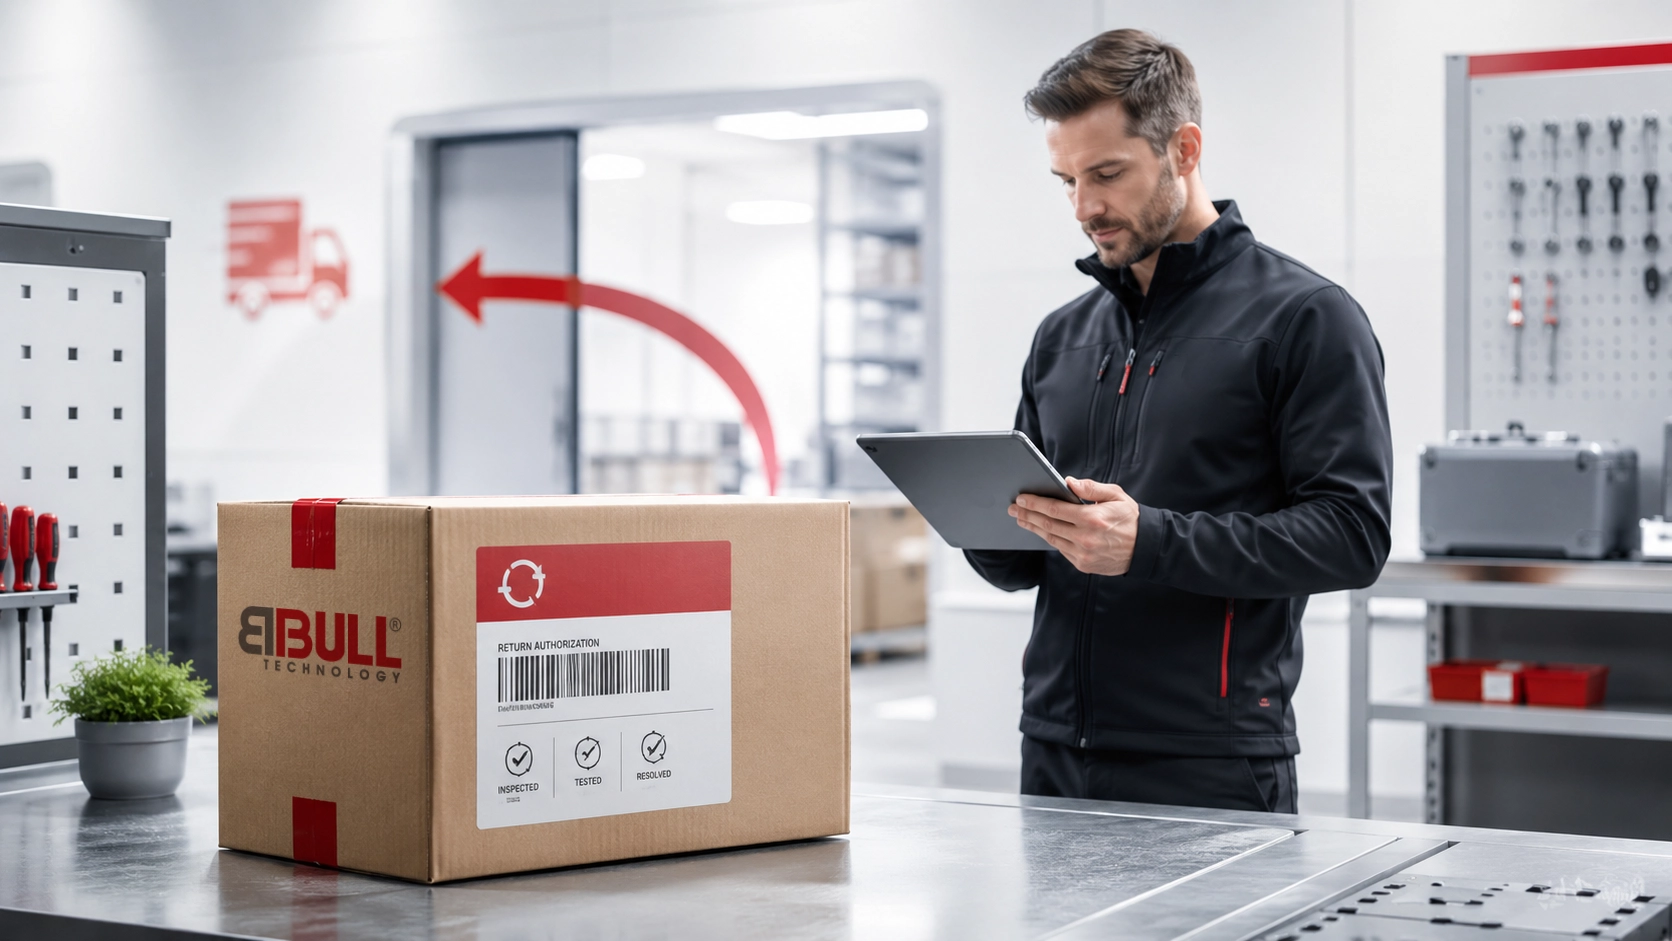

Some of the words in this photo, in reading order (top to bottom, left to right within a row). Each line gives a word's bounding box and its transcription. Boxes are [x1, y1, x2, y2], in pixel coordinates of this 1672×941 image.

[498, 642, 532, 653] RETURN
[534, 638, 600, 651] AUTHORIZATION
[263, 658, 401, 684] TECHNOLOGY
[574, 776, 602, 787] TESTED
[636, 769, 672, 781] RESOLVED
[497, 782, 540, 795] INSPECTED
